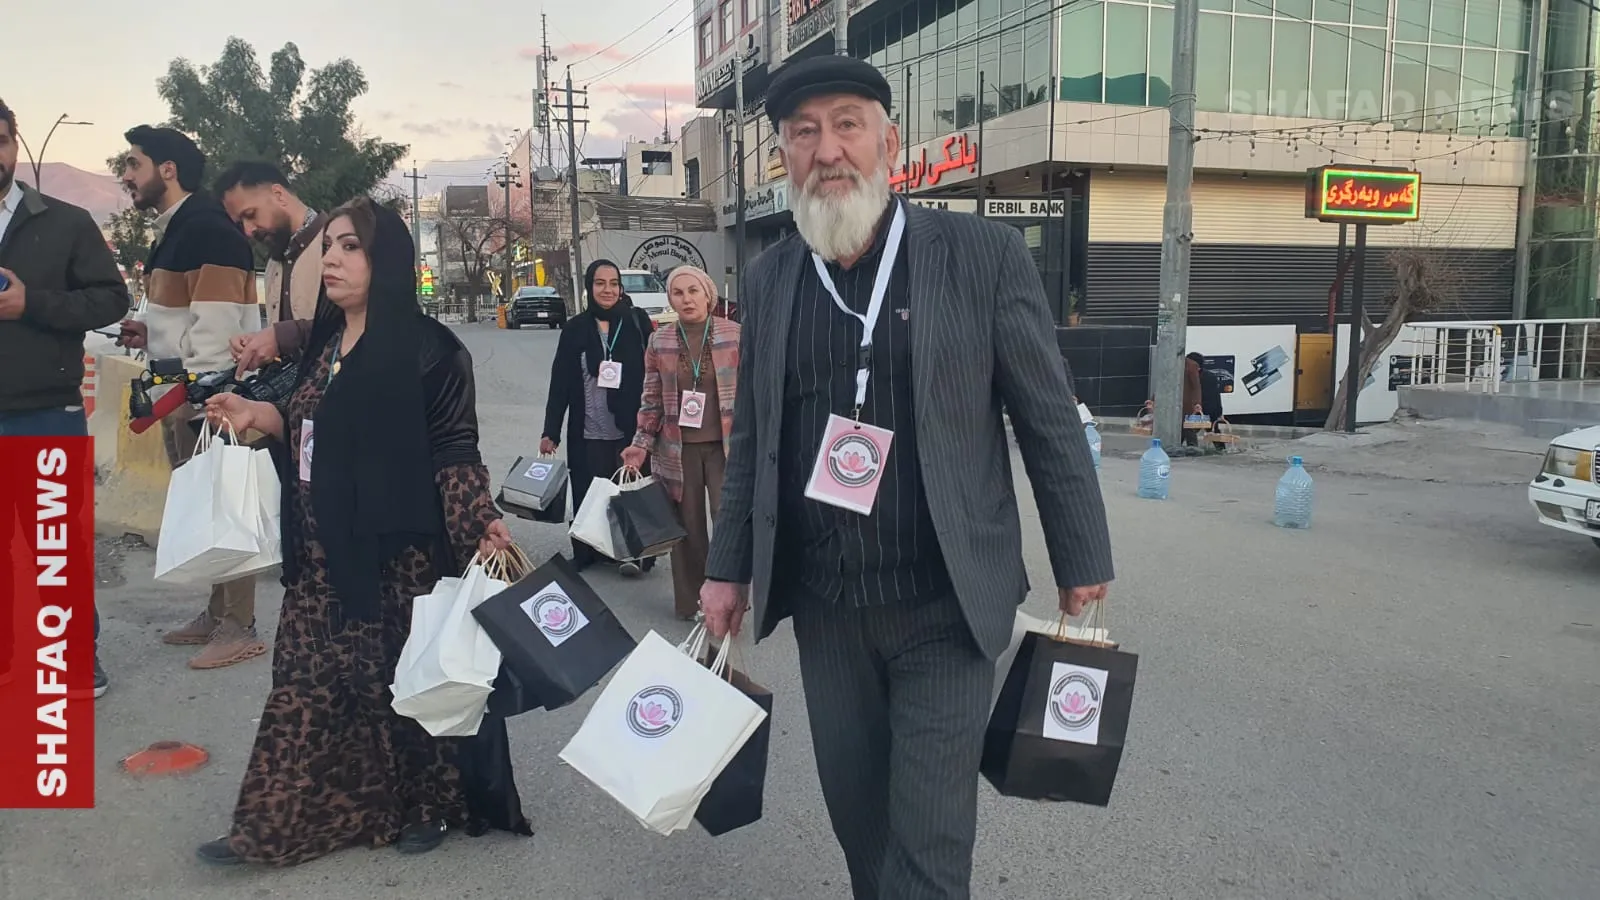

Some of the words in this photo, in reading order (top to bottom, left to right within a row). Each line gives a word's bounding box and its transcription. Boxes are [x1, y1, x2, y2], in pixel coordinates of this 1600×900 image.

[988, 202, 1025, 214] ERBIL
[1030, 202, 1064, 214] BANK
[647, 248, 670, 262] Mosul
[670, 248, 688, 263] Bank
